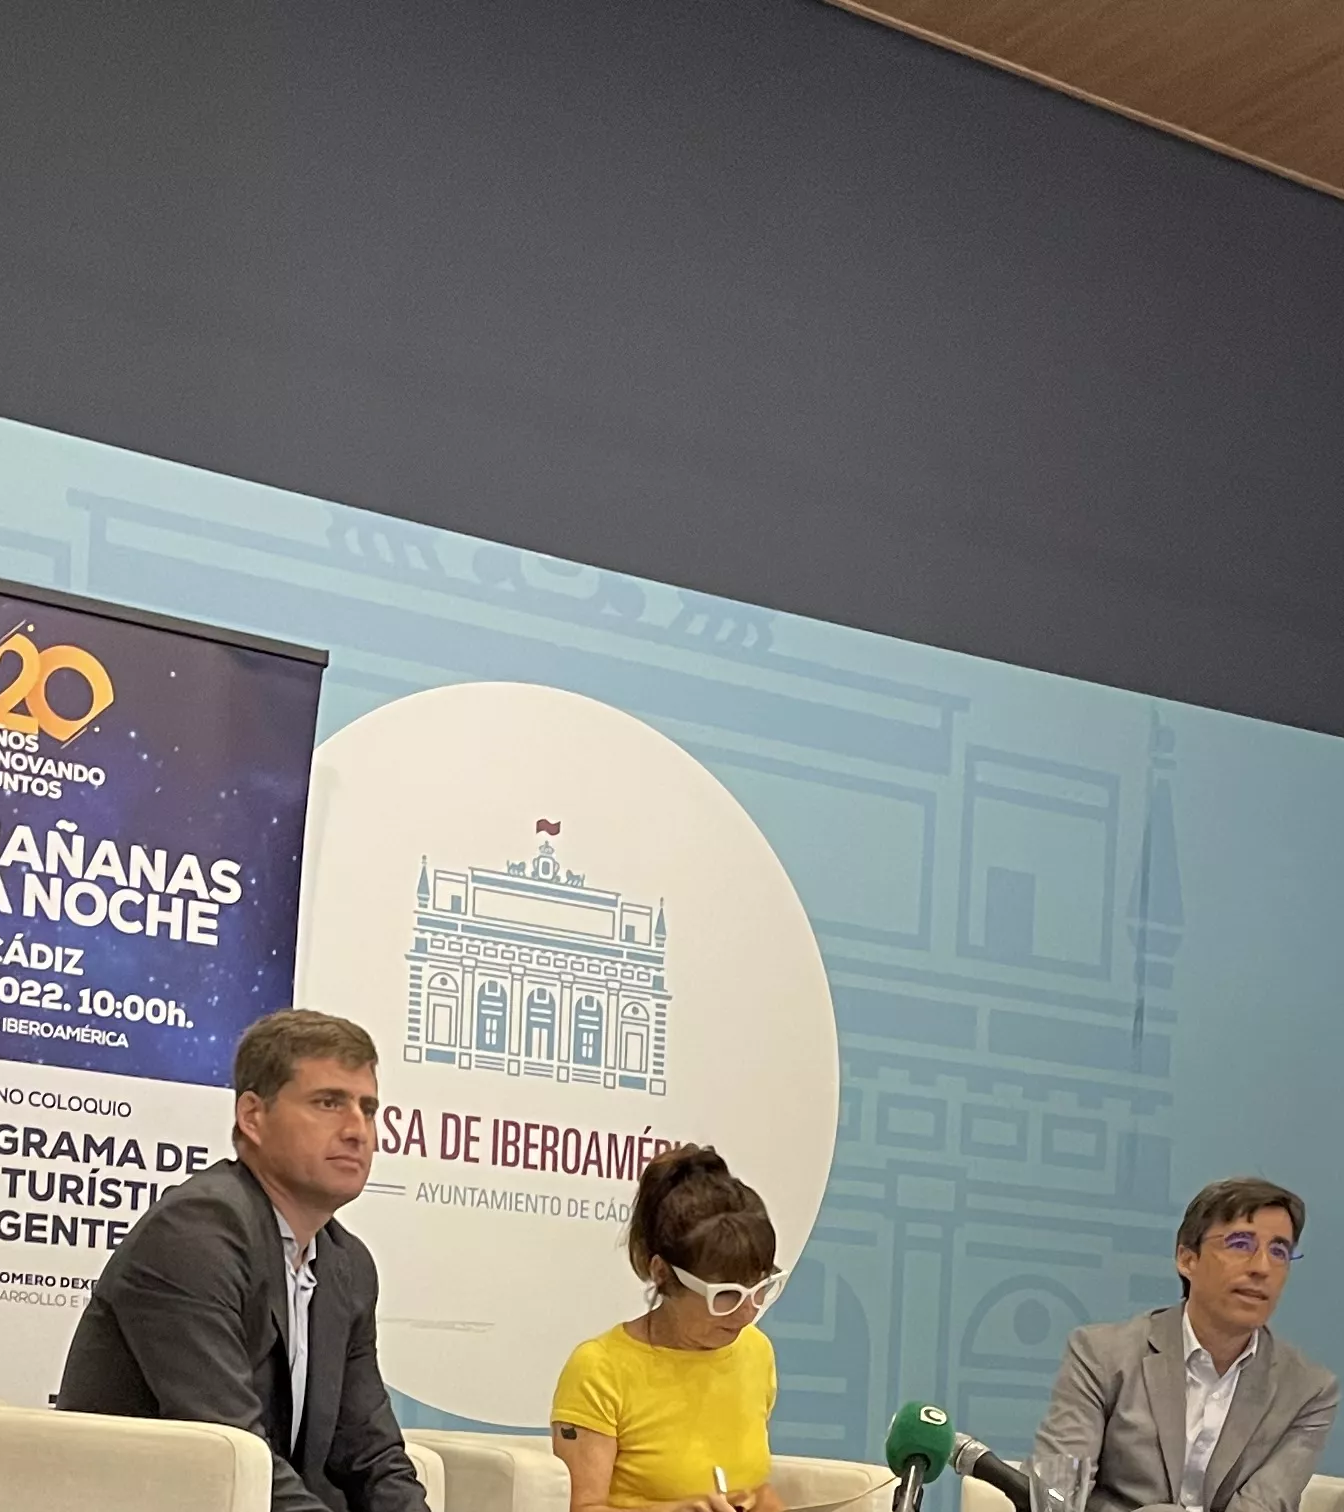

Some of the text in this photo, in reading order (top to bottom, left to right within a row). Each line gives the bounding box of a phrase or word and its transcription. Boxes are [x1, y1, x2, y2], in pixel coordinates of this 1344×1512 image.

[23, 874, 220, 946] NOCHE
[78, 988, 194, 1029] 10:00h.
[2, 1018, 129, 1048] IBEROAMÉRICA
[29, 1090, 132, 1118] COLOQUIO
[373, 1105, 427, 1157] SA
[440, 1112, 481, 1163] DE
[155, 1142, 209, 1174] DE
[1, 1168, 159, 1212] TURÍSTI
[416, 1182, 631, 1223] AYUNTAMIENTO DE CÁD
[70, 1294, 79, 1308] E
